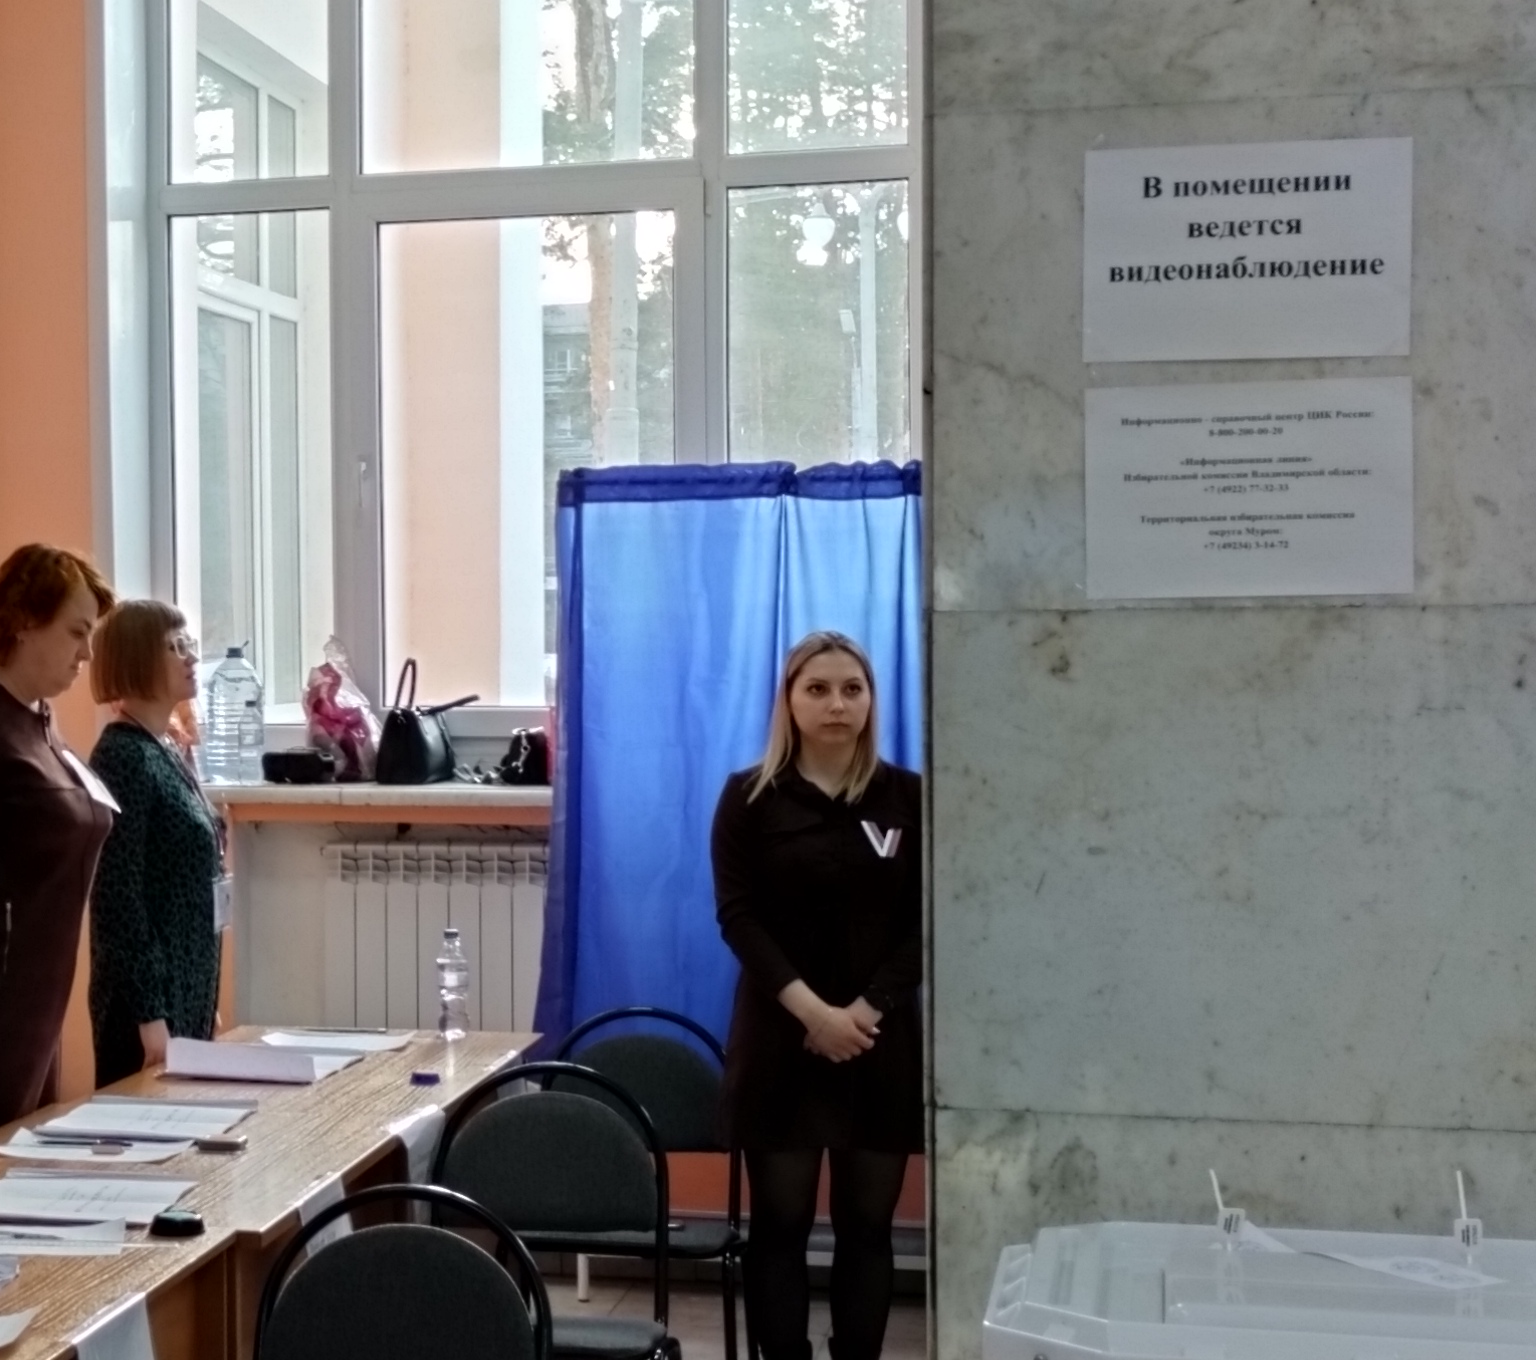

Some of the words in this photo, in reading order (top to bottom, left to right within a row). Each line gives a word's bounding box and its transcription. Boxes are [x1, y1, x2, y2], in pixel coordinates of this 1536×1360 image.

[1142, 175, 1163, 199] В
[1173, 173, 1352, 198] помещении
[1187, 217, 1303, 240] ведется
[1109, 256, 1385, 284] видеонаблюдение
